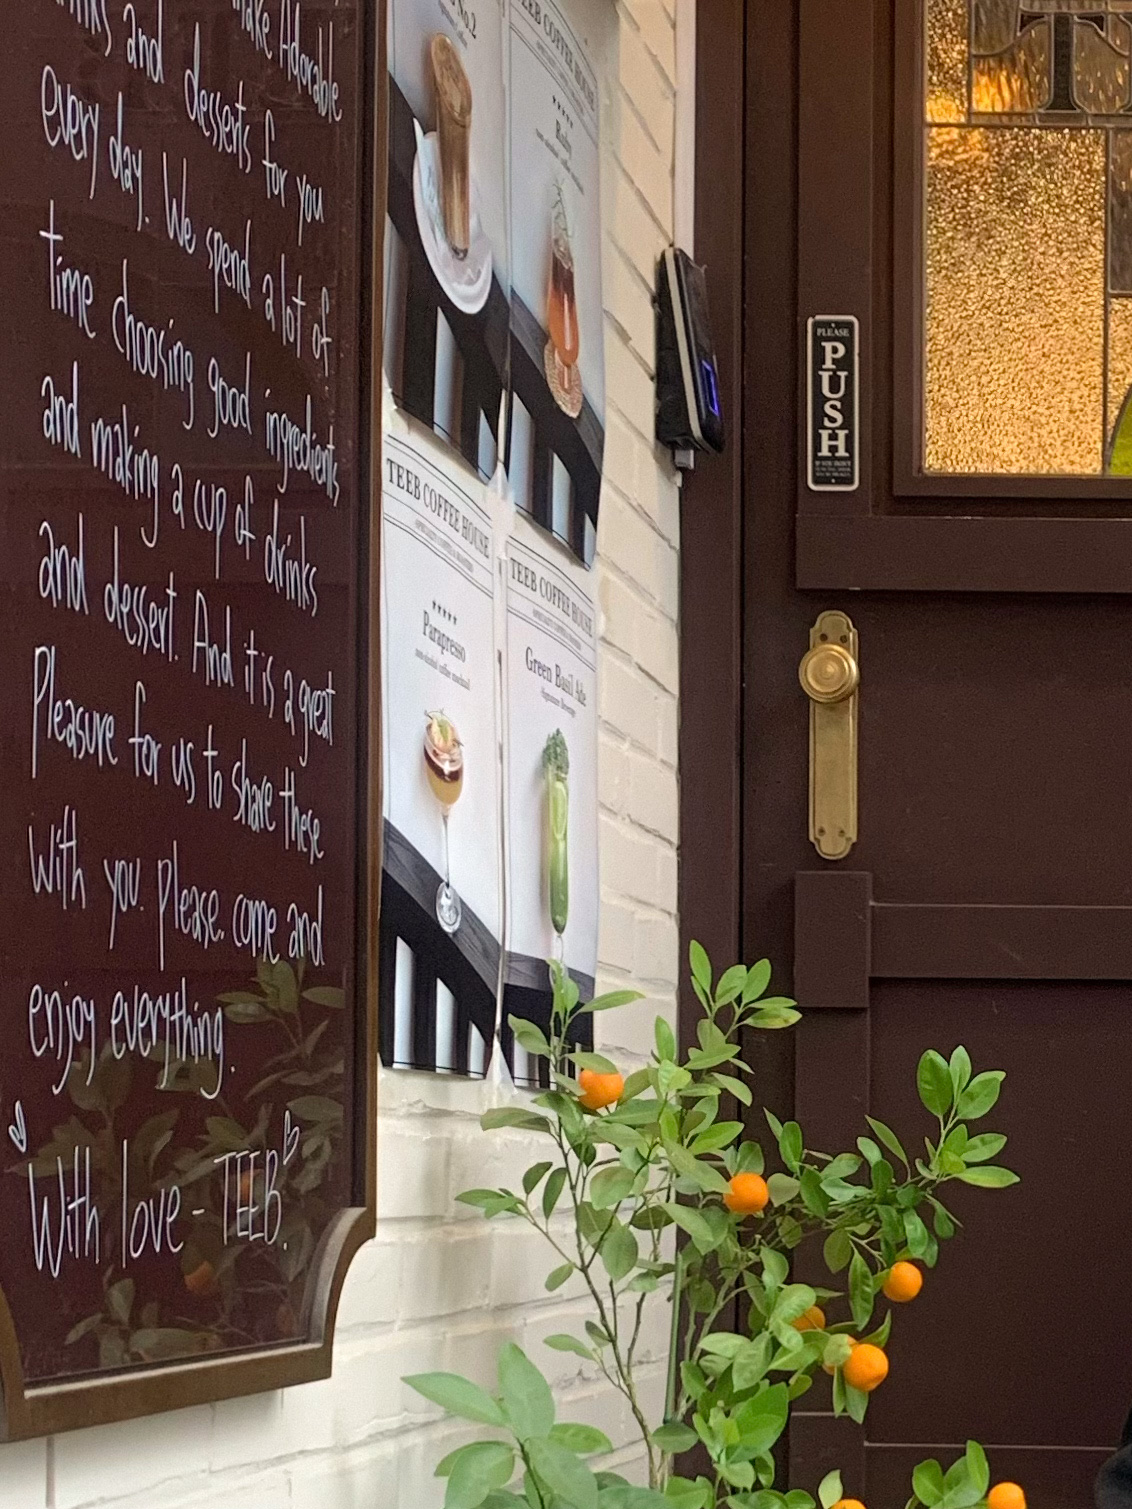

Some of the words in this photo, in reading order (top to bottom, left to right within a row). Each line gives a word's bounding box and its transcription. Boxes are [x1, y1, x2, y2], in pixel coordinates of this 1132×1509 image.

[122, 0, 165, 84] and
[184, 21, 251, 174] desserts
[261, 108, 288, 208] for
[296, 173, 325, 247] you
[108, 91, 151, 232] day.
[162, 151, 196, 255] We
[205, 218, 252, 314] spend
[262, 273, 276, 333] a
[280, 252, 306, 359] lot
[312, 286, 333, 378] of
[38, 199, 96, 339] time
[111, 258, 194, 430] choosing
[206, 351, 252, 438] good
[264, 388, 340, 508] ingredients
[816, 327, 850, 337] PLEASE
[817, 341, 850, 458] PUSH
[41, 360, 82, 459] and
[90, 403, 160, 548] making
[171, 463, 185, 530] a
[194, 479, 227, 580] cup
[234, 475, 256, 561] of
[264, 498, 318, 617] drinks
[386, 457, 421, 501] TEEB
[423, 482, 460, 533] COFFEE
[461, 514, 490, 559] HOUSE
[39, 512, 89, 615] and
[192, 589, 234, 687] And
[283, 669, 295, 736] a
[298, 670, 337, 768] great
[510, 557, 538, 593] TEEB
[539, 576, 571, 618] COFFEE
[525, 646, 553, 683] Green
[128, 680, 162, 787] for
[172, 737, 196, 804] us
[203, 724, 223, 810] to
[231, 737, 277, 834] share
[279, 766, 325, 865] these
[232, 893, 281, 965] come
[286, 884, 326, 967] and
[29, 981, 95, 1095] enjoy
[110, 977, 236, 1099] everything.
[121, 1138, 184, 1269] love
